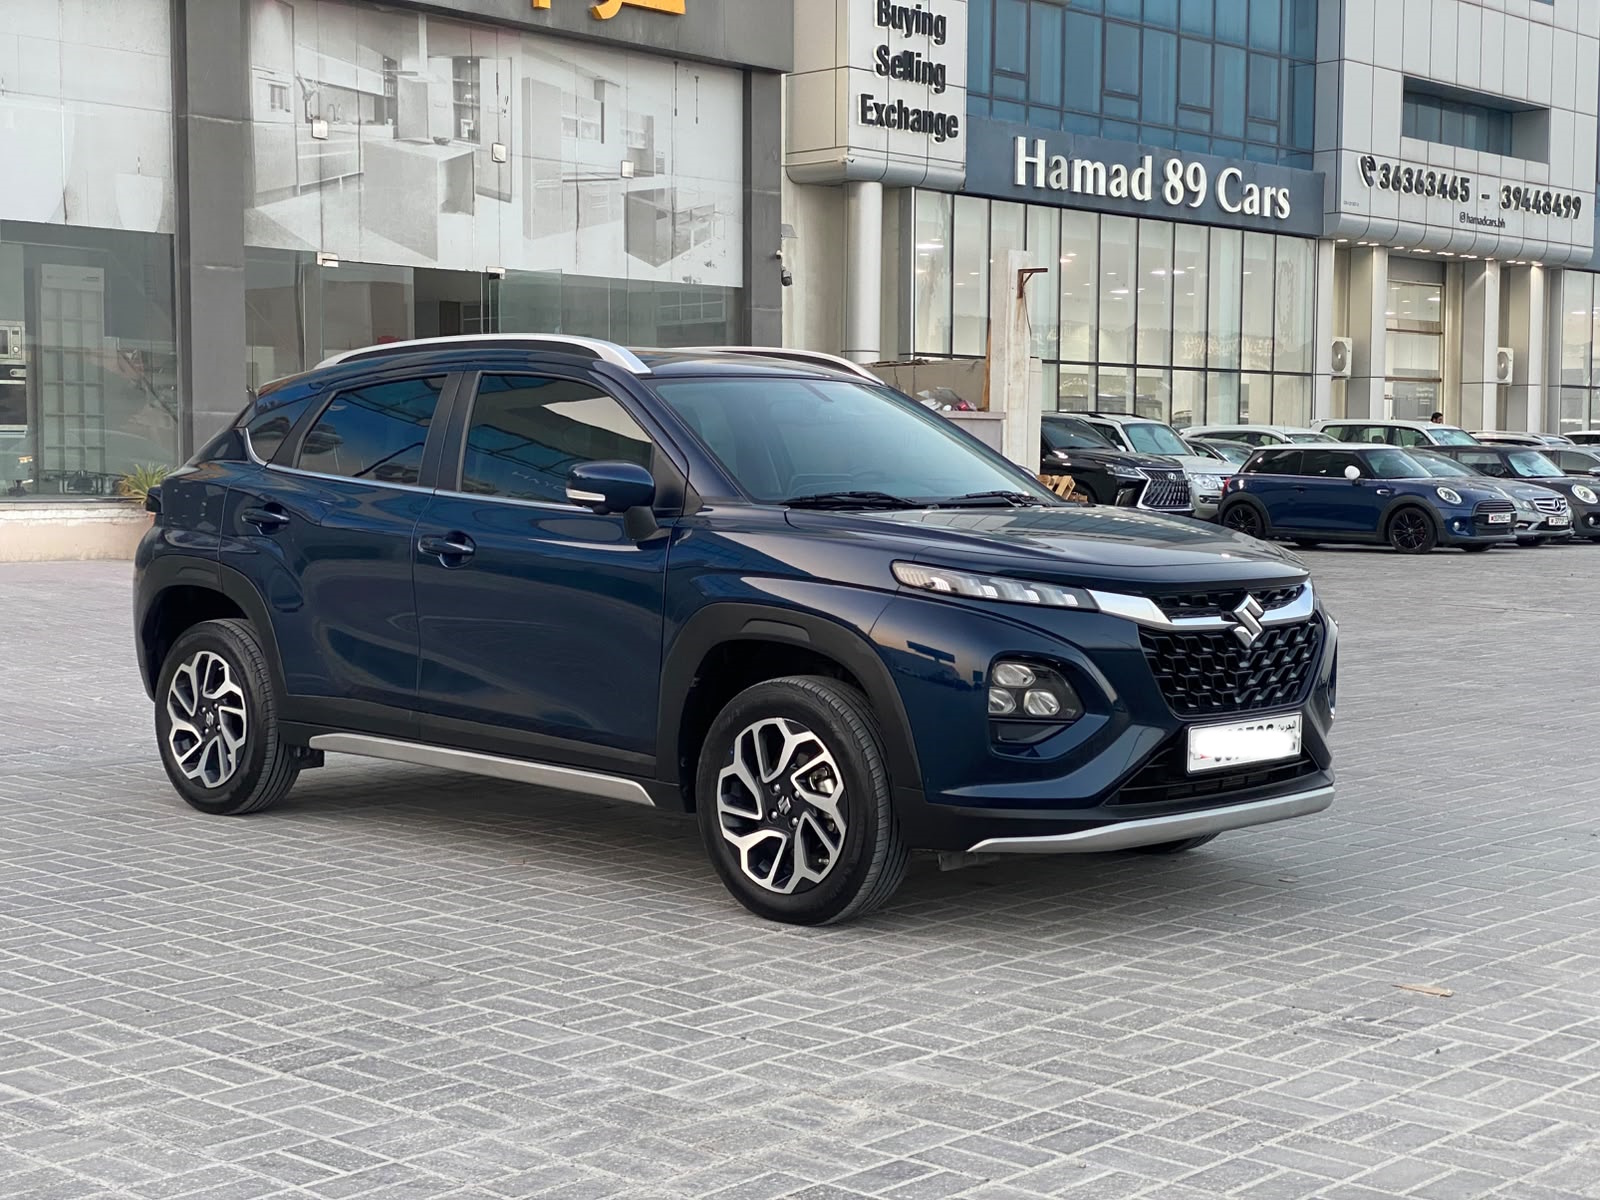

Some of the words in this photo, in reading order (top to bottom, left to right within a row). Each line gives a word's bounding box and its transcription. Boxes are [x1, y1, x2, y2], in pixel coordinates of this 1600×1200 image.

[876, 0, 947, 46] Buying
[875, 44, 947, 94] Selling
[859, 93, 959, 143] Exchange
[1014, 136, 1153, 202] Hamad
[1163, 158, 1208, 208] 89
[1215, 167, 1291, 219] Cars
[1379, 163, 1470, 203] 36363465
[1500, 185, 1581, 219] 39448499
